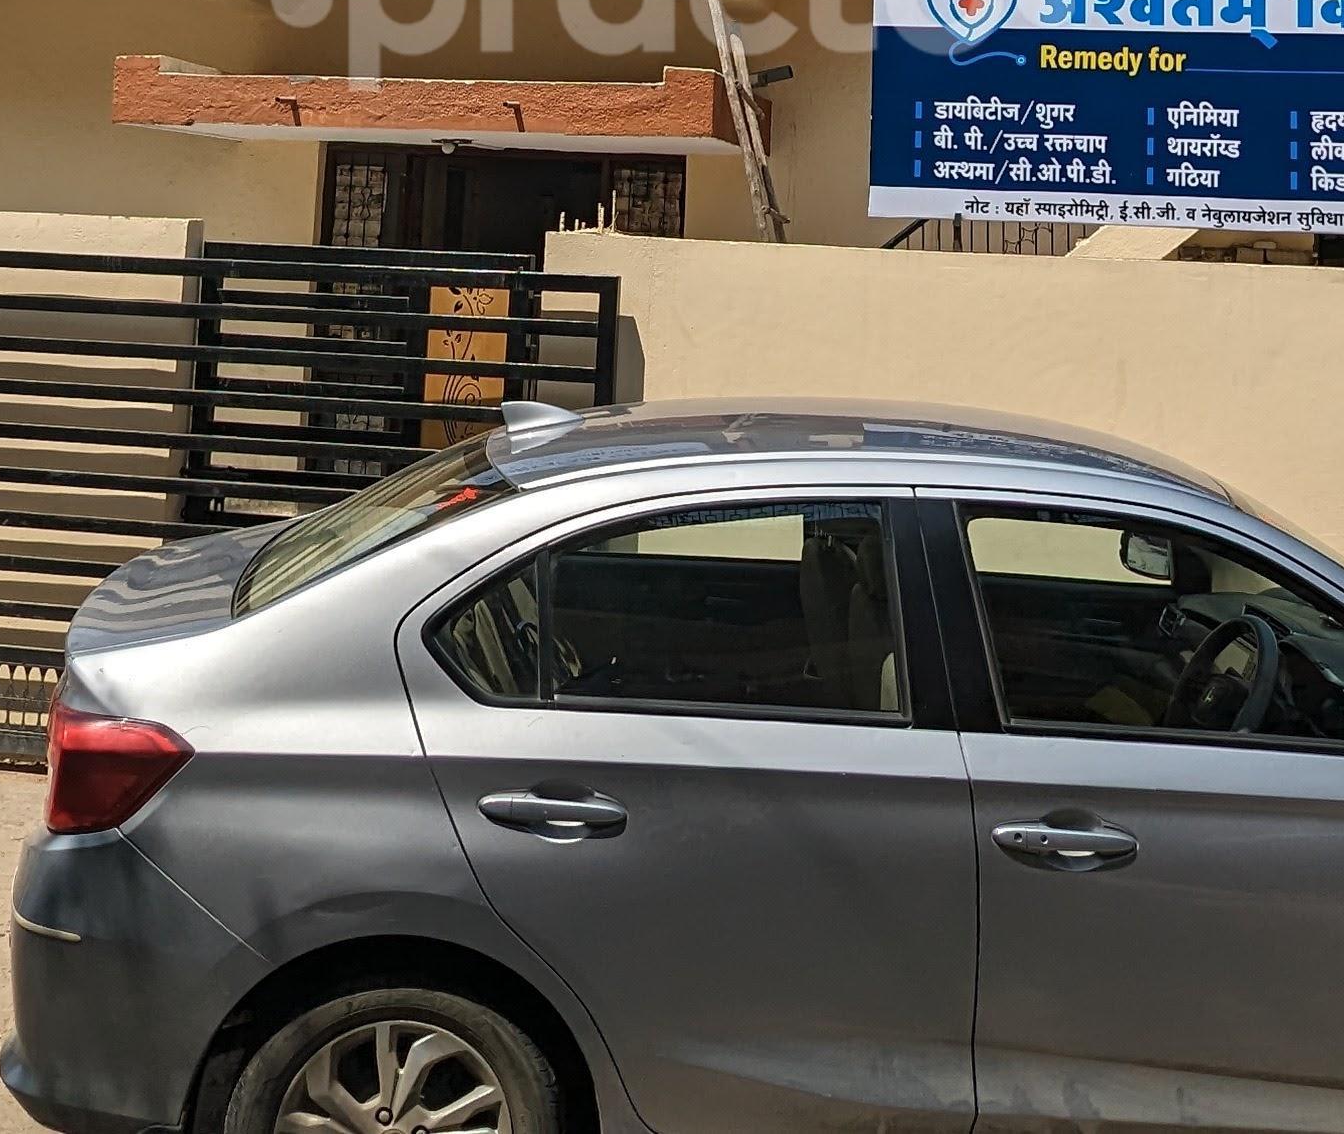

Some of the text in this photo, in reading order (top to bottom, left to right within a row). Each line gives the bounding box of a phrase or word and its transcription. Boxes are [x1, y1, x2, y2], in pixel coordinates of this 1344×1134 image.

[1039, 45, 1187, 76] Remedy for
[1167, 101, 1240, 129] एनिमिया
[933, 124, 958, 150] बी.
[1044, 134, 1108, 153] रक्तचाप
[1166, 162, 1220, 188] गठिया
[964, 196, 991, 214] नोट
[1119, 200, 1181, 222] ई.सी.जी.
[1186, 208, 1197, 221] व
[1201, 204, 1292, 228] नेबुलायजेशन
[1297, 207, 1344, 231] सुविधा
